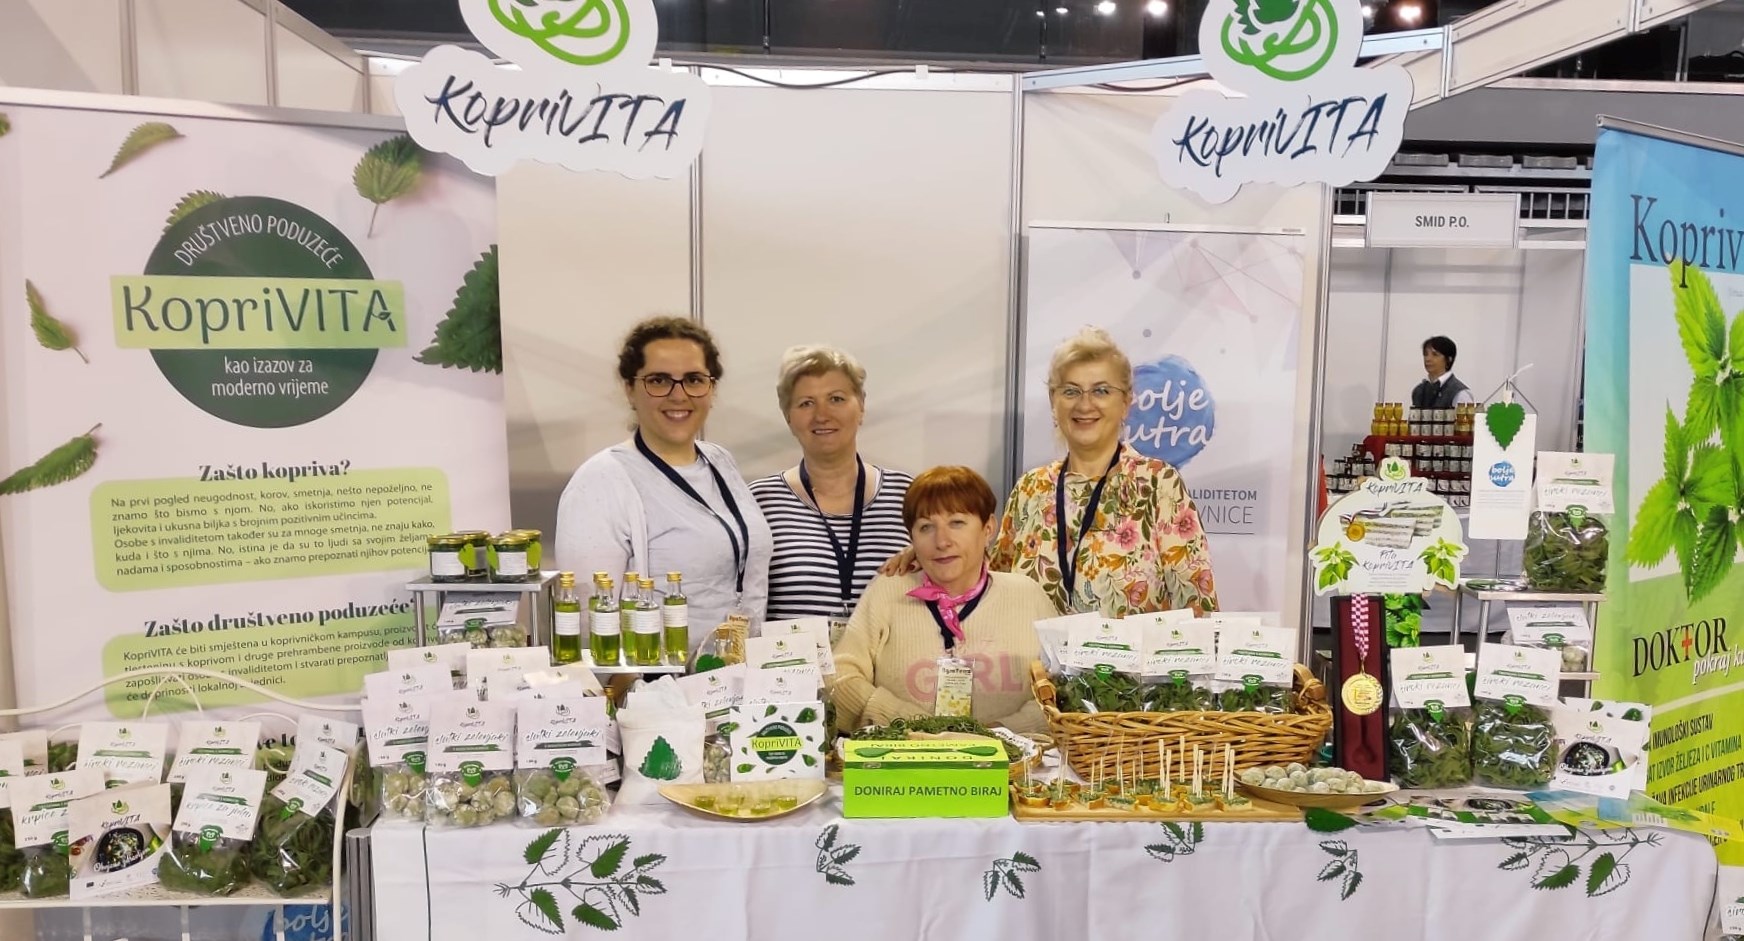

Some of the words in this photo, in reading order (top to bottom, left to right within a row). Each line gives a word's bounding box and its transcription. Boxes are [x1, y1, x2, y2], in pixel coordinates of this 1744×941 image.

[425, 75, 686, 152] KopriVITA
[1172, 93, 1388, 178] KopriVITA
[1415, 215, 1445, 228] SMID
[1449, 215, 1470, 228] P.O.
[174, 213, 263, 267] DRUŠTVENO
[266, 215, 345, 270] PODUZEĆE
[1630, 194, 1744, 288] Kopriv
[122, 285, 397, 345] KopriVITA
[225, 357, 250, 374] kao
[253, 356, 294, 374] izazov
[298, 361, 313, 374] za
[211, 379, 275, 397] moderno
[279, 379, 329, 398] vrijeme
[1132, 379, 1209, 421] olje
[1125, 418, 1210, 449] utra
[199, 464, 258, 482] Zašto
[262, 459, 351, 483] kopriva?
[110, 498, 126, 507] Na
[130, 497, 150, 509] prvi
[154, 494, 190, 507] pogled
[193, 492, 257, 504] neugodnost,
[260, 490, 289, 499] korov,
[293, 488, 332, 498] smetnja,
[336, 486, 362, 495] nešto
[365, 484, 418, 495] nepoželjno,
[112, 513, 148, 521] znamo
[154, 509, 170, 519] što
[176, 508, 207, 517] bismo
[224, 506, 253, 516] njom.
[282, 502, 299, 511] ako
[304, 500, 356, 510] iskoristimo
[360, 498, 381, 509] njen
[113, 525, 157, 537] ljekovita
[165, 522, 201, 531] ukusna
[203, 520, 230, 530] biljka
[240, 517, 278, 528] brojnim
[280, 514, 331, 526] pozitivnim
[332, 511, 377, 521] učincima.
[114, 538, 148, 548] Osobe
[158, 534, 224, 545] invaliditetom
[227, 531, 264, 541] također
[294, 528, 328, 537] mnoge
[330, 524, 369, 534] smetnja,
[385, 521, 410, 532] znaju
[115, 552, 142, 562] kuda
[153, 550, 169, 559] što
[182, 547, 213, 559] njima.
[239, 544, 265, 553] istina
[269, 543, 278, 553] je
[282, 541, 294, 550] da
[314, 540, 324, 548] to
[328, 538, 348, 549] ljudi
[366, 535, 395, 546] svojim
[116, 565, 158, 576] nadama
[166, 559, 242, 573] sposobnostima
[253, 556, 271, 565] ako
[273, 556, 306, 564] znamo
[308, 549, 358, 564] prepoznati
[360, 548, 389, 559] njihov
[390, 545, 429, 557] potencij
[144, 618, 204, 638] Zašto
[208, 610, 314, 632] društveno
[318, 598, 415, 626] poduzeće
[123, 648, 173, 662] KopriVITA
[175, 646, 187, 655] će
[189, 644, 206, 654] biti
[208, 640, 258, 653] smještena
[270, 632, 335, 647] koprivničkom
[337, 627, 382, 639] kampusu,
[187, 655, 234, 668] koprivom
[244, 650, 273, 662] druge
[277, 645, 341, 660] prehrambene
[344, 639, 390, 652] proizvode
[392, 634, 405, 645] od
[300, 655, 335, 668] stvarati
[337, 652, 388, 669] prepoznatlj
[126, 691, 139, 701] će
[198, 679, 238, 692] lokalnoj
[905, 652, 1023, 702] GRL
[752, 738, 801, 750] KopriVITA
[1652, 720, 1688, 750] IMUNOLOŠKI
[1690, 713, 1713, 737] SUSTAV
[1658, 756, 1675, 779] IZVOR
[1675, 747, 1700, 772] ŽELJEZA
[1711, 733, 1741, 758] VITAMINA
[854, 786, 905, 796] DONIRAJ
[909, 786, 967, 796] PAMETNO
[971, 786, 1002, 796] BIRAJ
[1668, 777, 1698, 806] INFEKCIJE
[1698, 765, 1735, 793] URINARNOG
